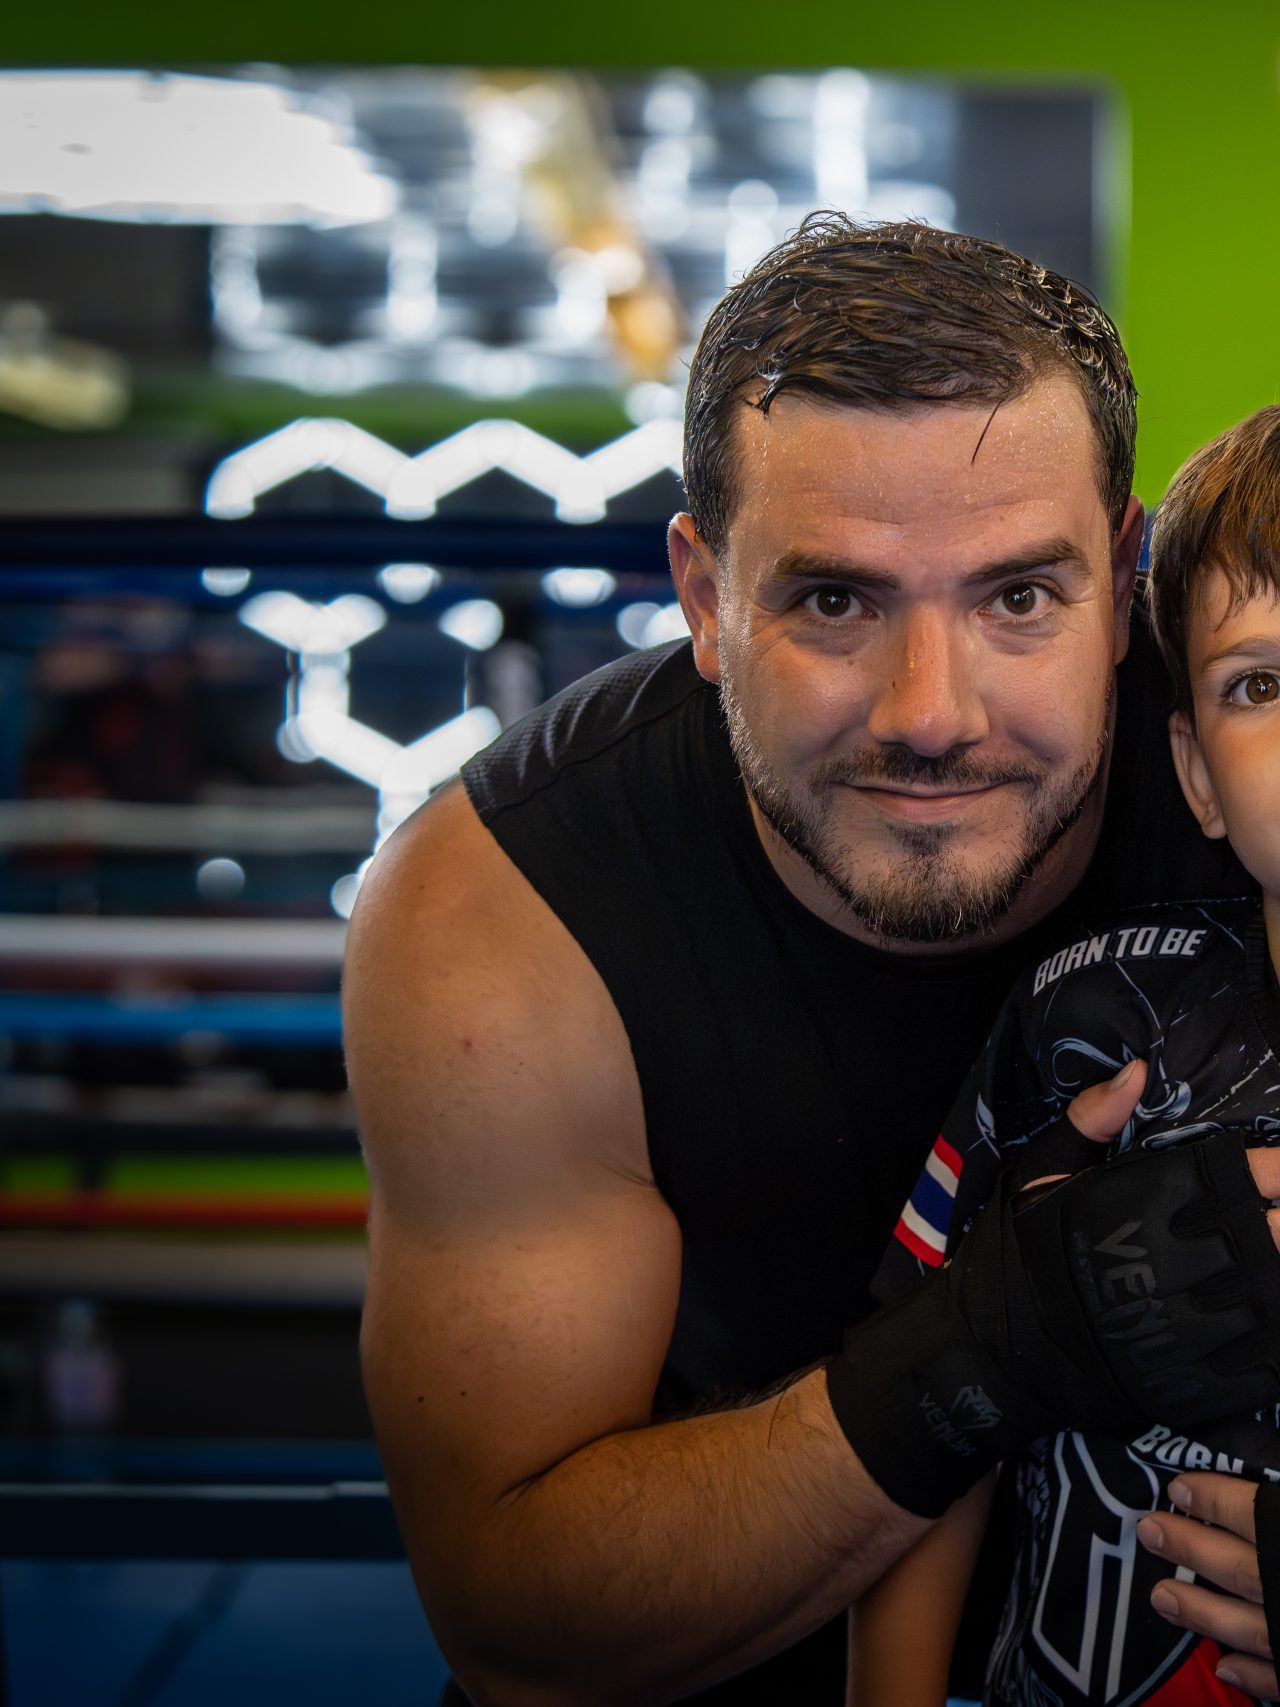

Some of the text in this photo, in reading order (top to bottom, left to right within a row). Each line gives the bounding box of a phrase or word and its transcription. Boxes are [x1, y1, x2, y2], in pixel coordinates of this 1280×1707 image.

[1033, 927, 1207, 996] BORN TO BE
[1131, 1424, 1244, 1474] BORN
